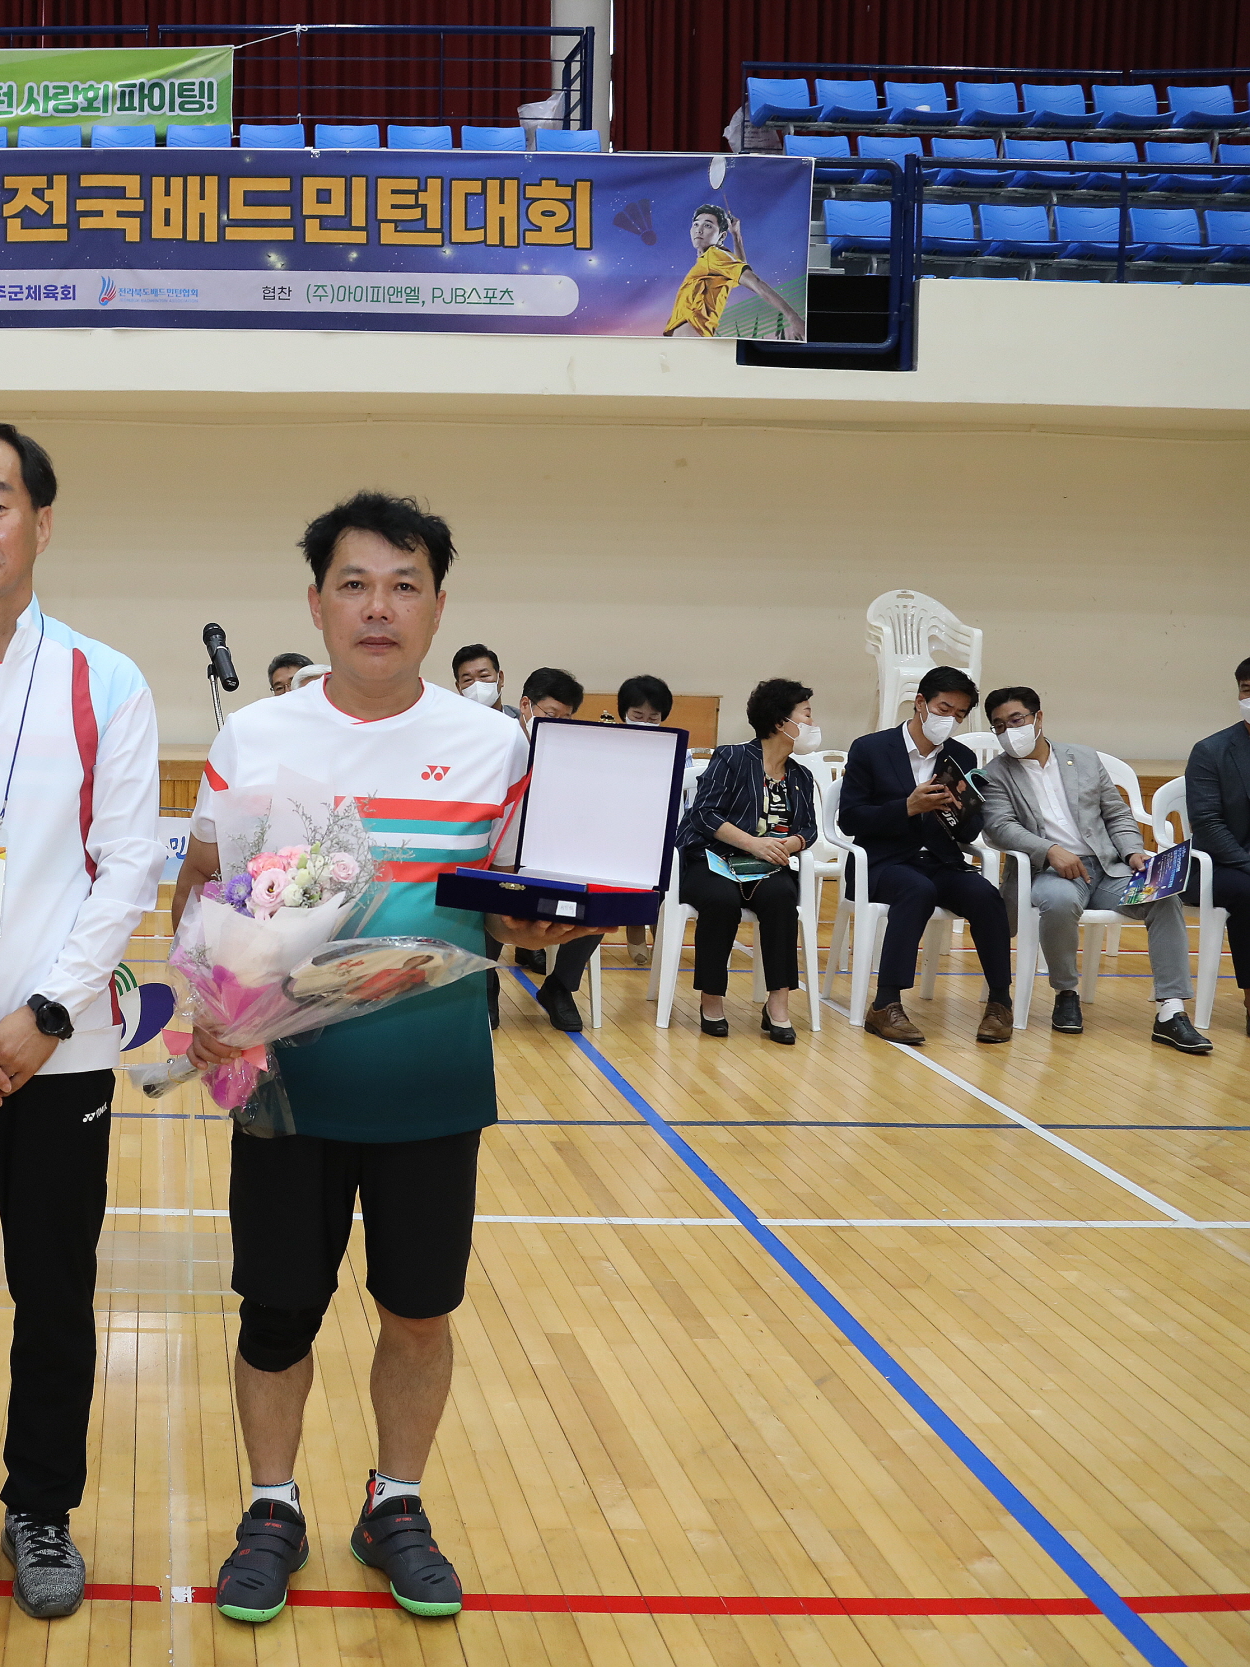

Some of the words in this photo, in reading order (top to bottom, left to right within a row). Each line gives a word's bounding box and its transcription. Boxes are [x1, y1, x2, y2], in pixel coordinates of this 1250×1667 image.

[21, 81, 110, 117] 사랑회
[116, 79, 218, 115] 파이팅!
[2, 173, 593, 250] 전국배드민턴대회
[118, 287, 199, 298] 전라북도배드민턴협회
[262, 284, 292, 302] 협찬
[305, 283, 425, 308] (주)아이피앤엘,
[431, 286, 514, 306] PJB스포츠
